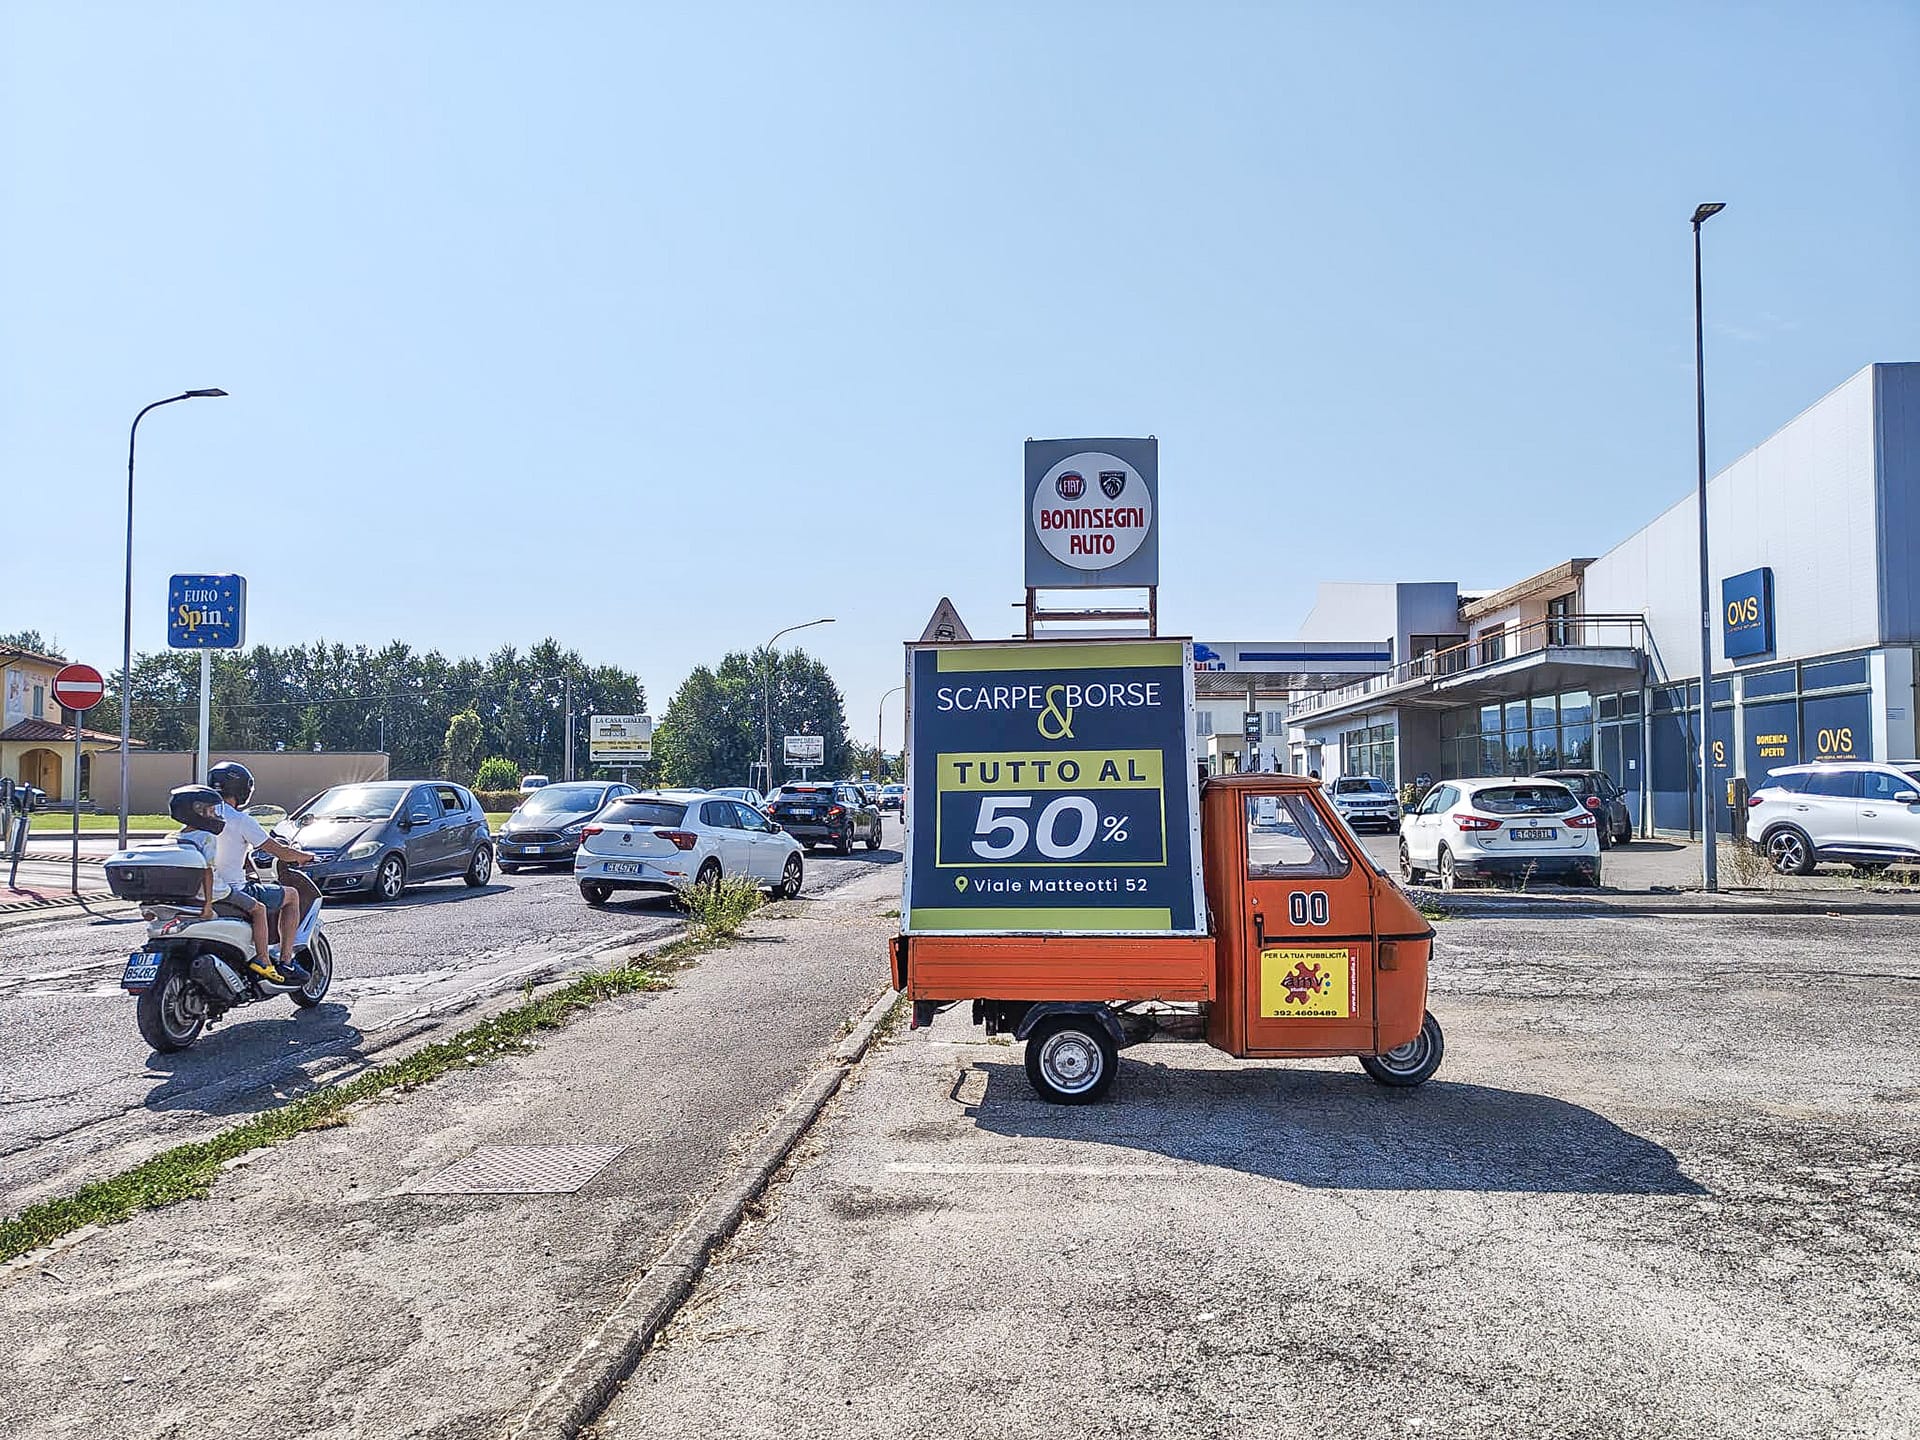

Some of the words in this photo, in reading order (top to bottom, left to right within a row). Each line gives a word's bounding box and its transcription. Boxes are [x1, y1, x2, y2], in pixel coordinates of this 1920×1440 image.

[1063, 479, 1080, 493] FIAT
[1041, 508, 1144, 529] BONINSEGNI
[1070, 534, 1115, 555] AUTO
[184, 589, 218, 602] EURO
[178, 604, 223, 632] Spin
[1728, 596, 1758, 625] OVS
[1194, 663, 1226, 671] UILA
[937, 686, 1043, 711] SCARPE
[1037, 684, 1075, 740] &
[1066, 682, 1161, 708] BORSE
[1757, 735, 1788, 745] DOMENICA
[1818, 727, 1852, 753] OVS
[1760, 747, 1785, 757] APERTO
[953, 759, 1080, 784] TUTTO
[1098, 758, 1146, 782] AL
[974, 878, 1022, 892] Viale
[1029, 878, 1118, 892] Matteotti
[1125, 878, 1147, 892] 52
[1289, 891, 1329, 926] 00
